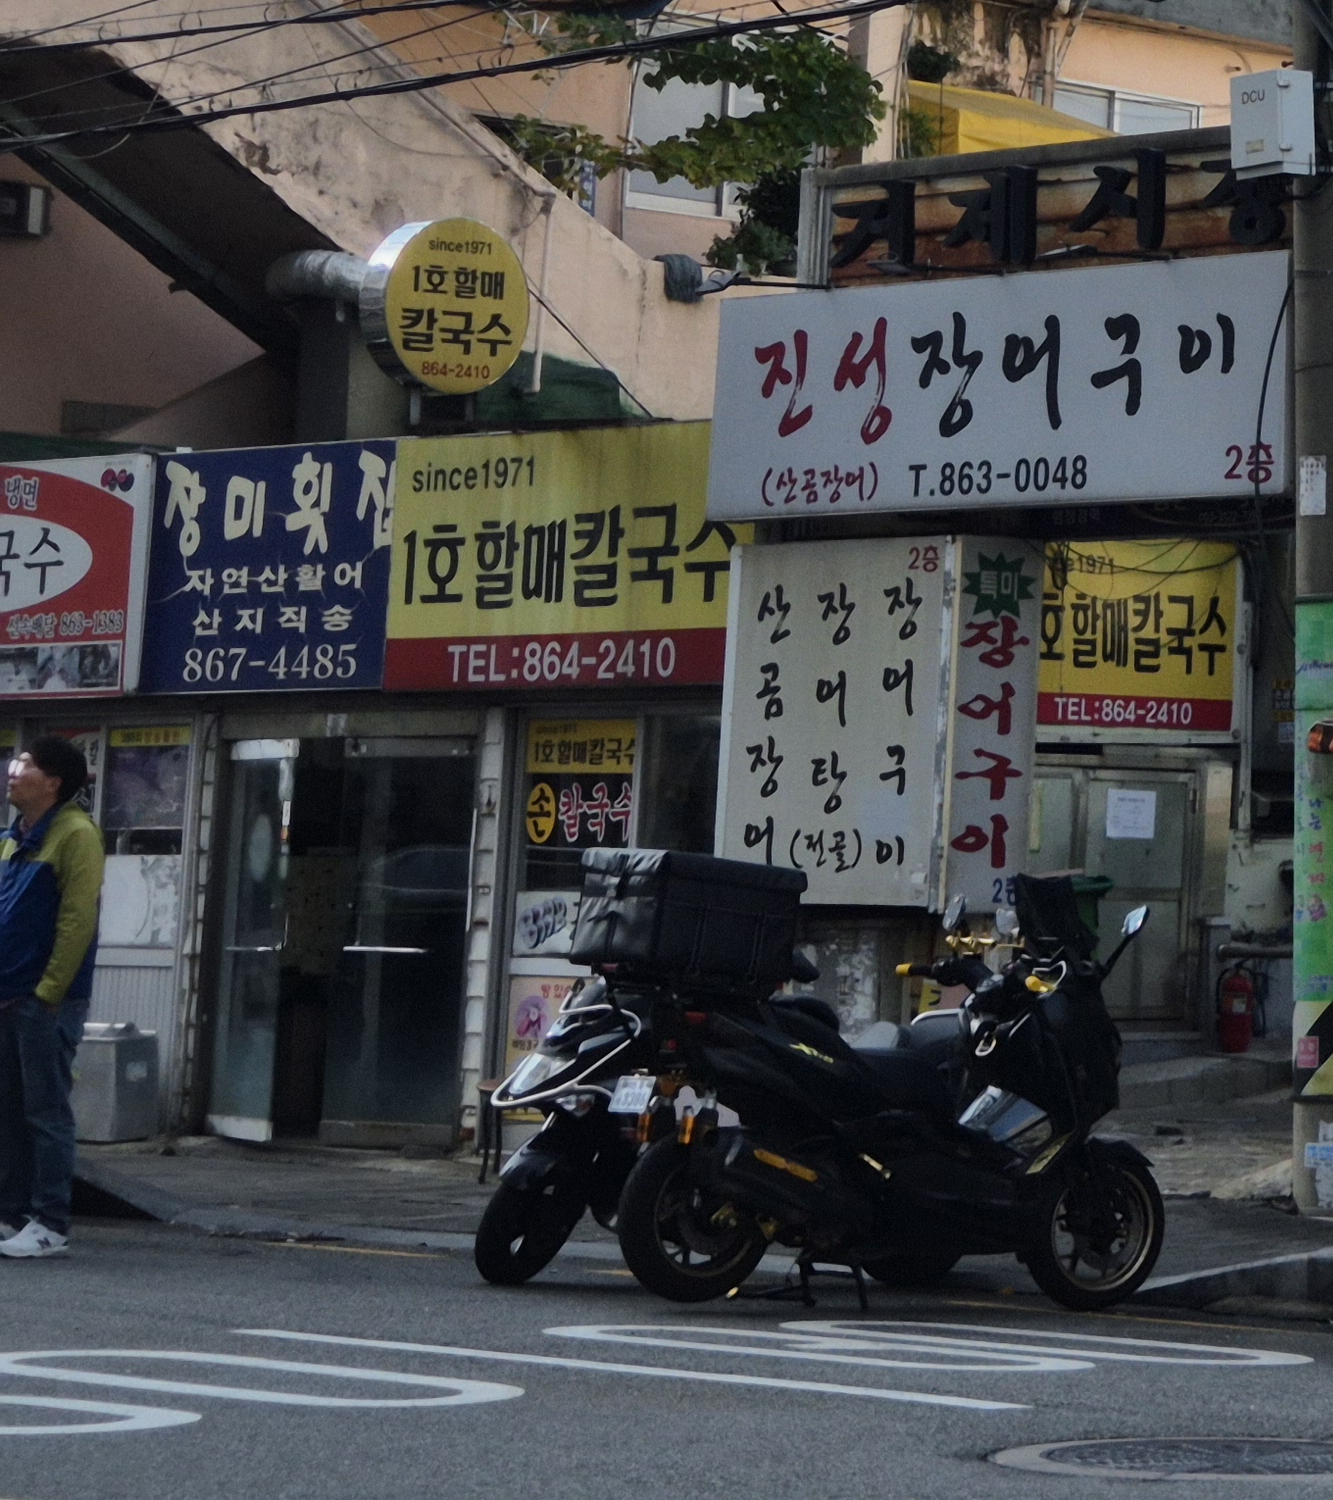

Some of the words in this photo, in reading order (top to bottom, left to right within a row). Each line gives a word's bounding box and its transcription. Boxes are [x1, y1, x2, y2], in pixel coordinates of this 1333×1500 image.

[1241, 89, 1265, 105] DCU
[428, 238, 492, 256] since1971
[410, 264, 506, 301] 1호할매
[399, 307, 513, 357] 칼국수
[421, 361, 490, 380] 864-2410
[755, 316, 893, 445] 진성
[910, 311, 1237, 439] 장어구이
[411, 455, 536, 494] since1971
[908, 454, 1088, 498] T.863-0048
[1224, 442, 1275, 484] 2층
[4, 476, 40, 512] 냉면
[402, 501, 732, 611] 1호할매칼국수
[908, 545, 940, 573] 2층
[183, 561, 365, 596] 자연산활어
[191, 603, 354, 637] 산지직송
[181, 643, 358, 683] 867-4485
[446, 638, 677, 684] TEL:864-2410
[874, 577, 924, 866] 장어구이
[1053, 696, 1193, 727] TEL:864-2410
[950, 614, 1031, 870] 장어구이
[558, 782, 633, 843] 칼국수
